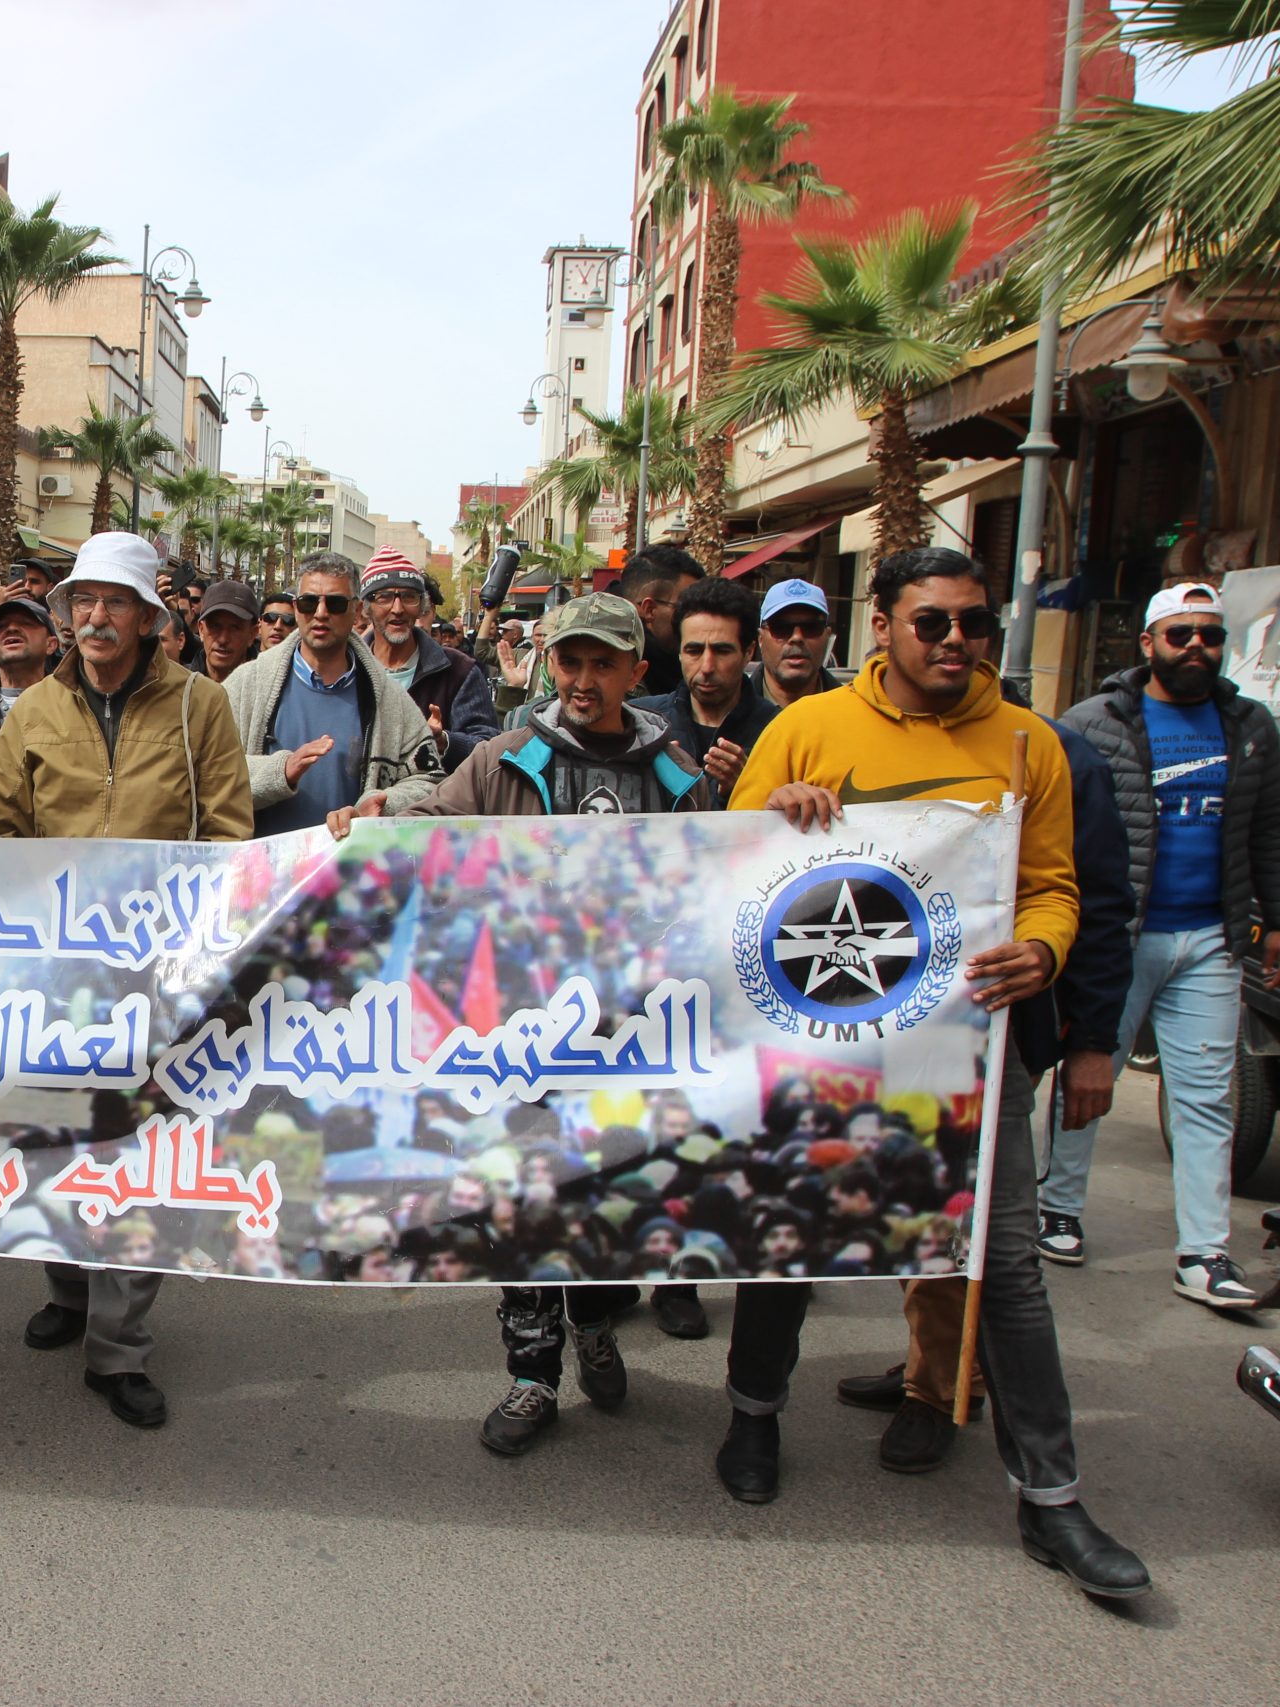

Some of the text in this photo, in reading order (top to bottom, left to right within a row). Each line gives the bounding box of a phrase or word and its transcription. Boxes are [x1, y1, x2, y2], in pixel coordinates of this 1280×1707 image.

[1197, 770, 1223, 779] CITY
[802, 842, 874, 873] المغربي
[756, 860, 797, 902] للشغل
[166, 996, 412, 1101] النقابي
[435, 990, 713, 1100] المكتب
[807, 1017, 886, 1043] UMT
[53, 1117, 276, 1229] يطالب
